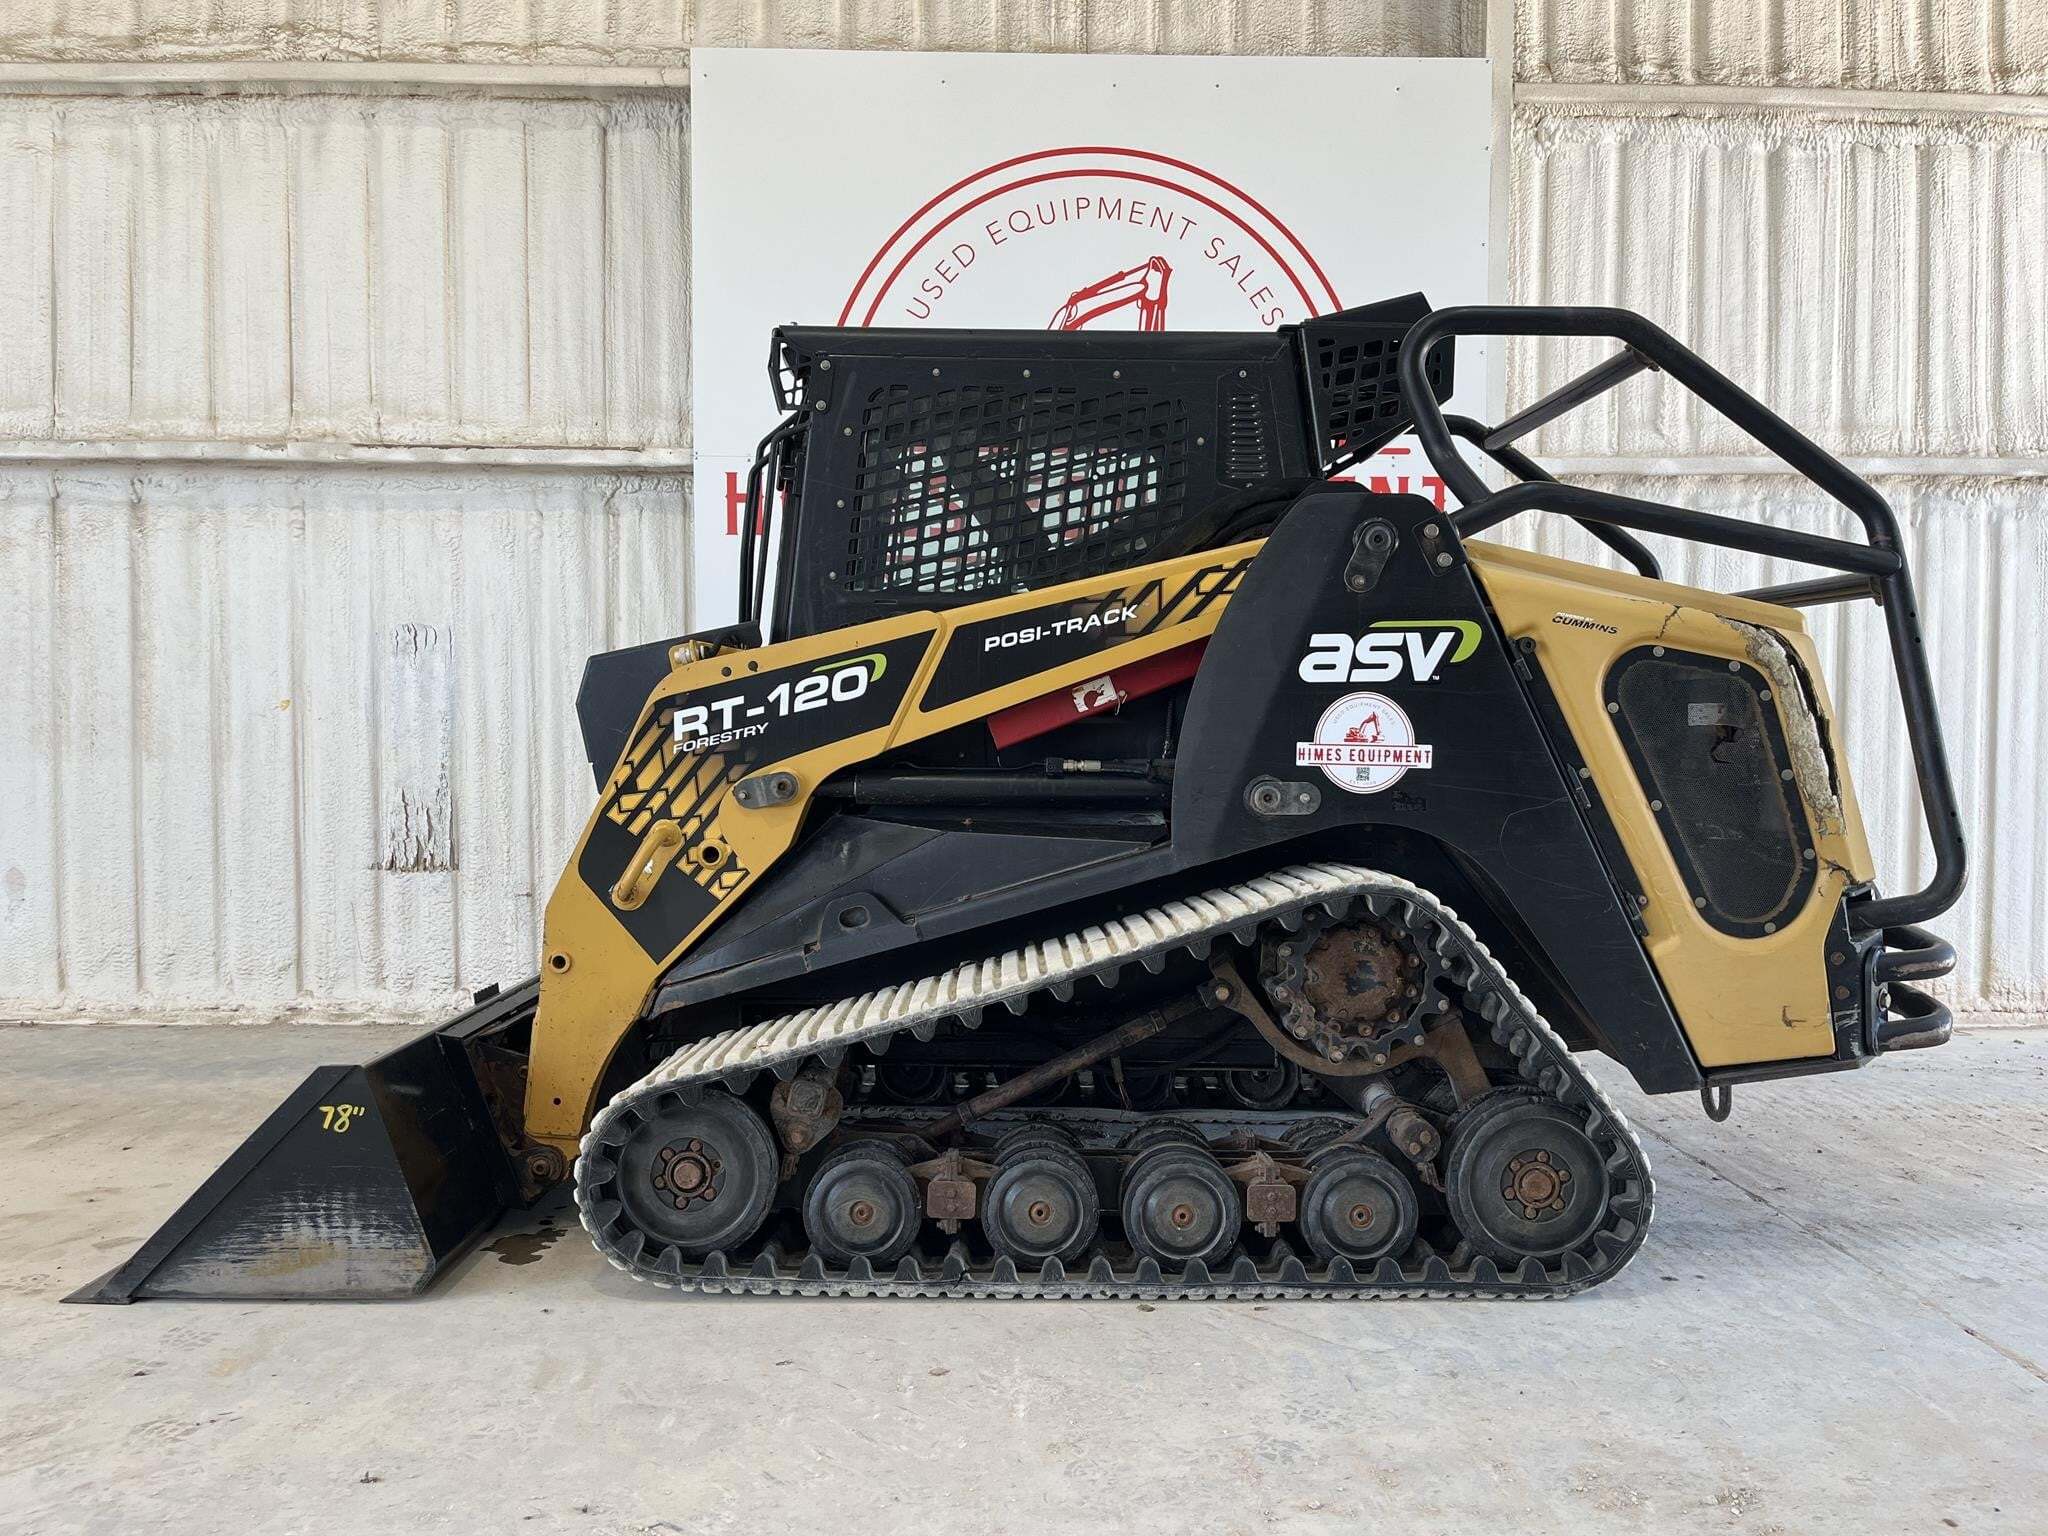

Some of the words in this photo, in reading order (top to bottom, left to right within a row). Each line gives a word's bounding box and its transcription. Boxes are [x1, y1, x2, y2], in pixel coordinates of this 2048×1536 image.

[906, 243, 976, 320] USED
[986, 196, 1198, 246] EQUIPMENT
[1204, 237, 1284, 327] SALES
[984, 604, 1138, 652] POSI-TRACK
[1552, 615, 1618, 634] CUMMINS
[673, 665, 868, 742] RT-120
[673, 721, 769, 755] FORESTRY
[1298, 747, 1342, 761] HIMES
[1349, 748, 1431, 764] EQUIPMENT
[319, 1103, 365, 1133] 78"
